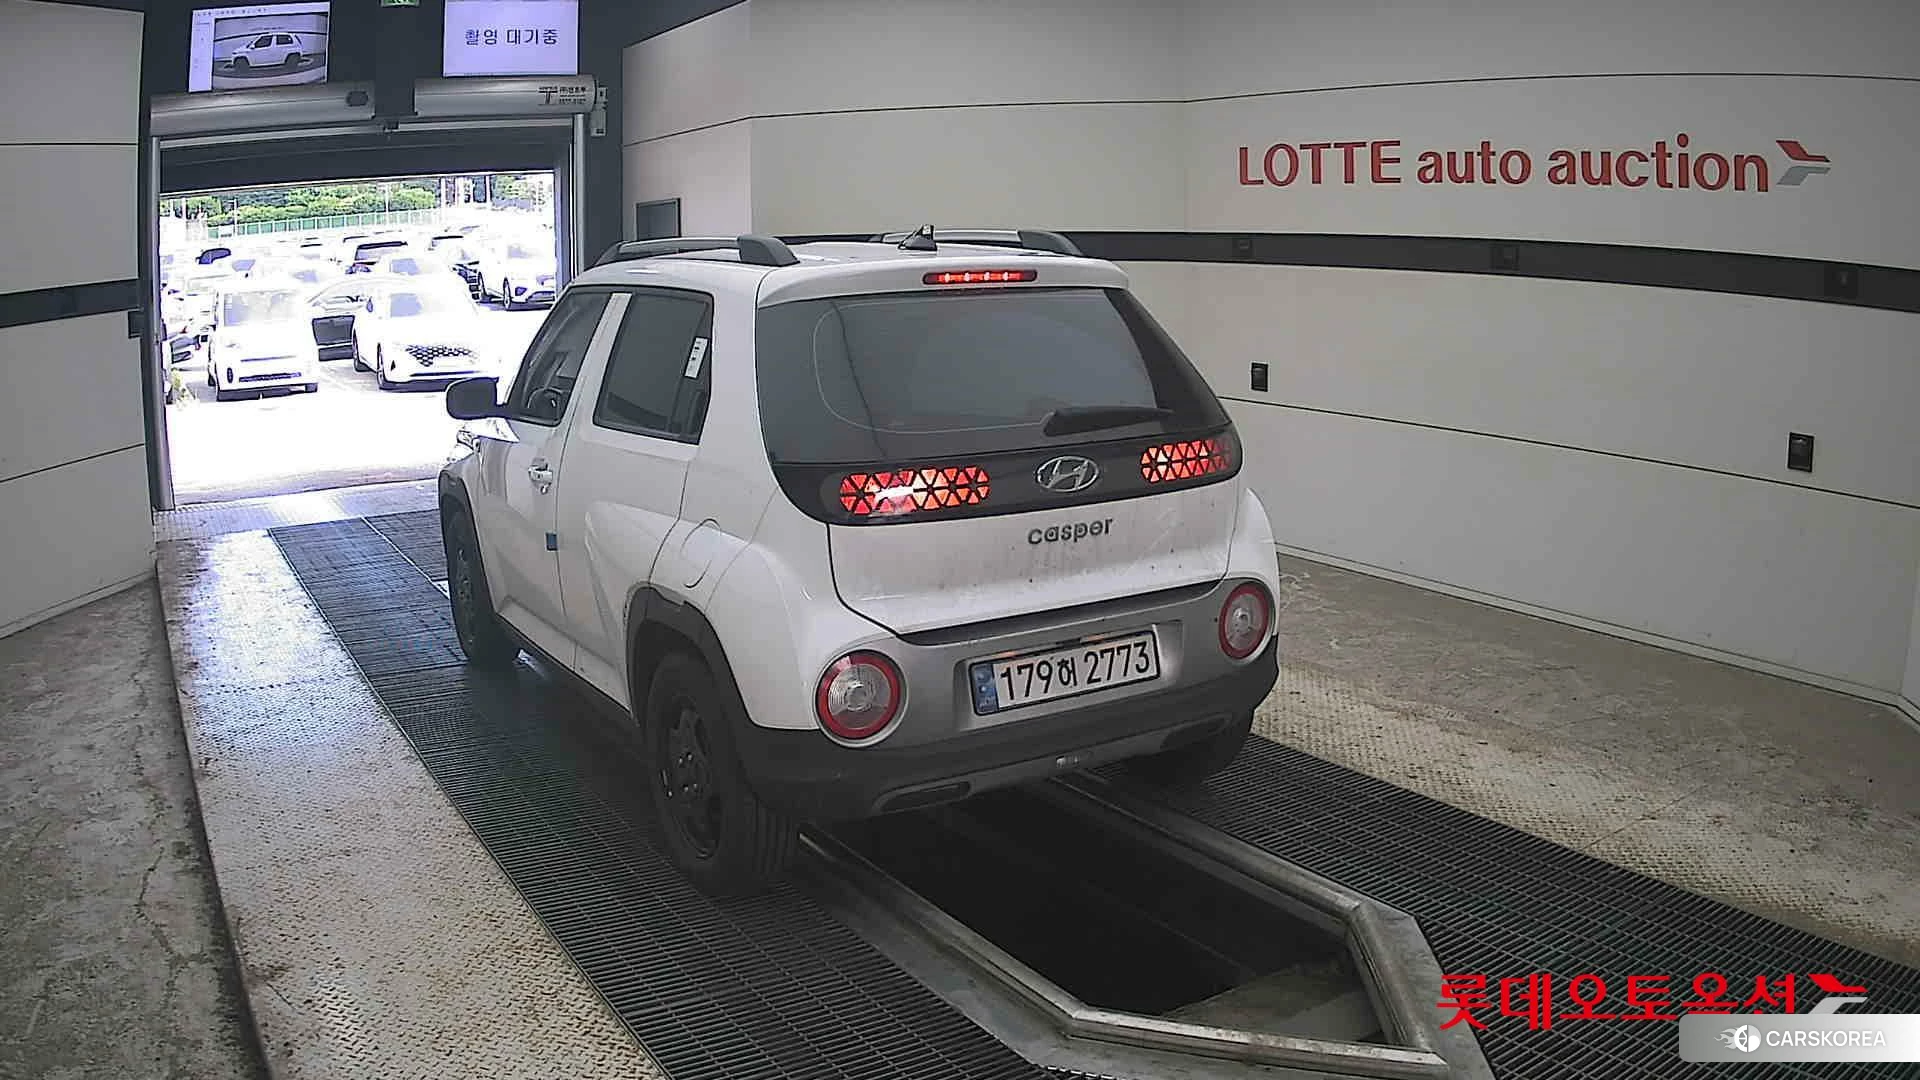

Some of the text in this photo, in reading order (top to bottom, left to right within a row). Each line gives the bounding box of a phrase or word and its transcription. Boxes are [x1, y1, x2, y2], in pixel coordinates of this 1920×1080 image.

[465, 28, 558, 46] 촬영 대기중
[1239, 134, 1769, 192] LOTTE auto auction
[1028, 518, 1112, 544] casper
[1084, 641, 1150, 685] 2773
